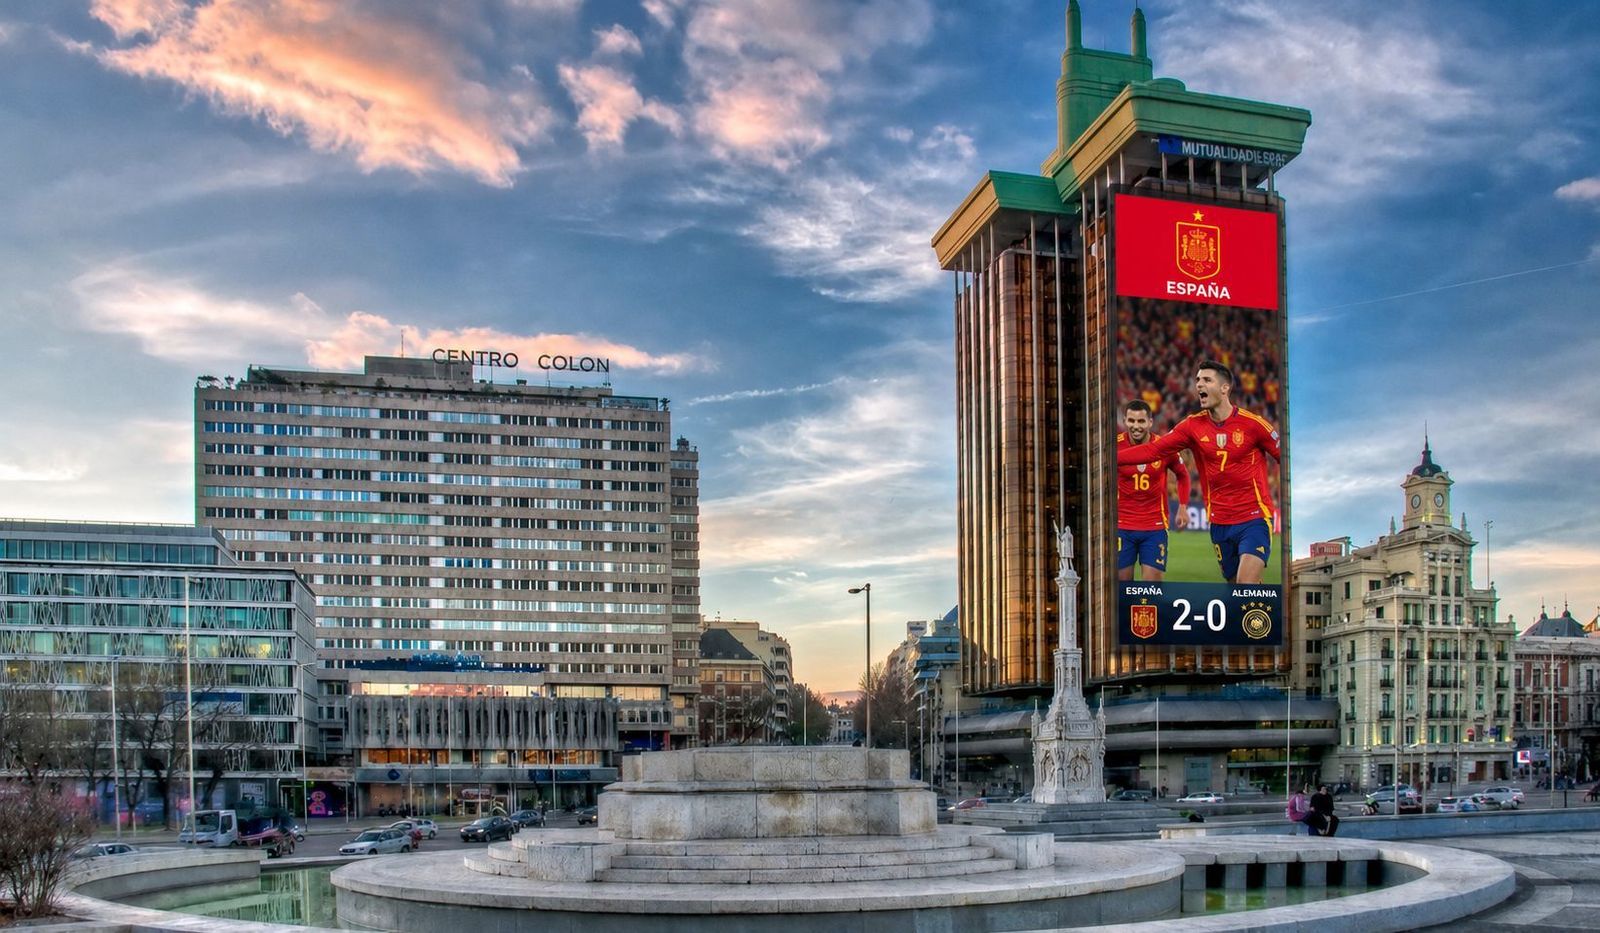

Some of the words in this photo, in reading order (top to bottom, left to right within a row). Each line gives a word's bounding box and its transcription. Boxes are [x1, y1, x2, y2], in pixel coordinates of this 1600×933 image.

[1167, 280, 1230, 300] ESPAÑA
[432, 348, 519, 368] CENTRO
[537, 354, 610, 373] COLON
[1216, 450, 1228, 472] 7
[1131, 473, 1150, 490] 16
[1125, 584, 1163, 596] ESPAÑA
[1232, 588, 1278, 598] ALEMANIA
[1172, 598, 1227, 632] 2-0
